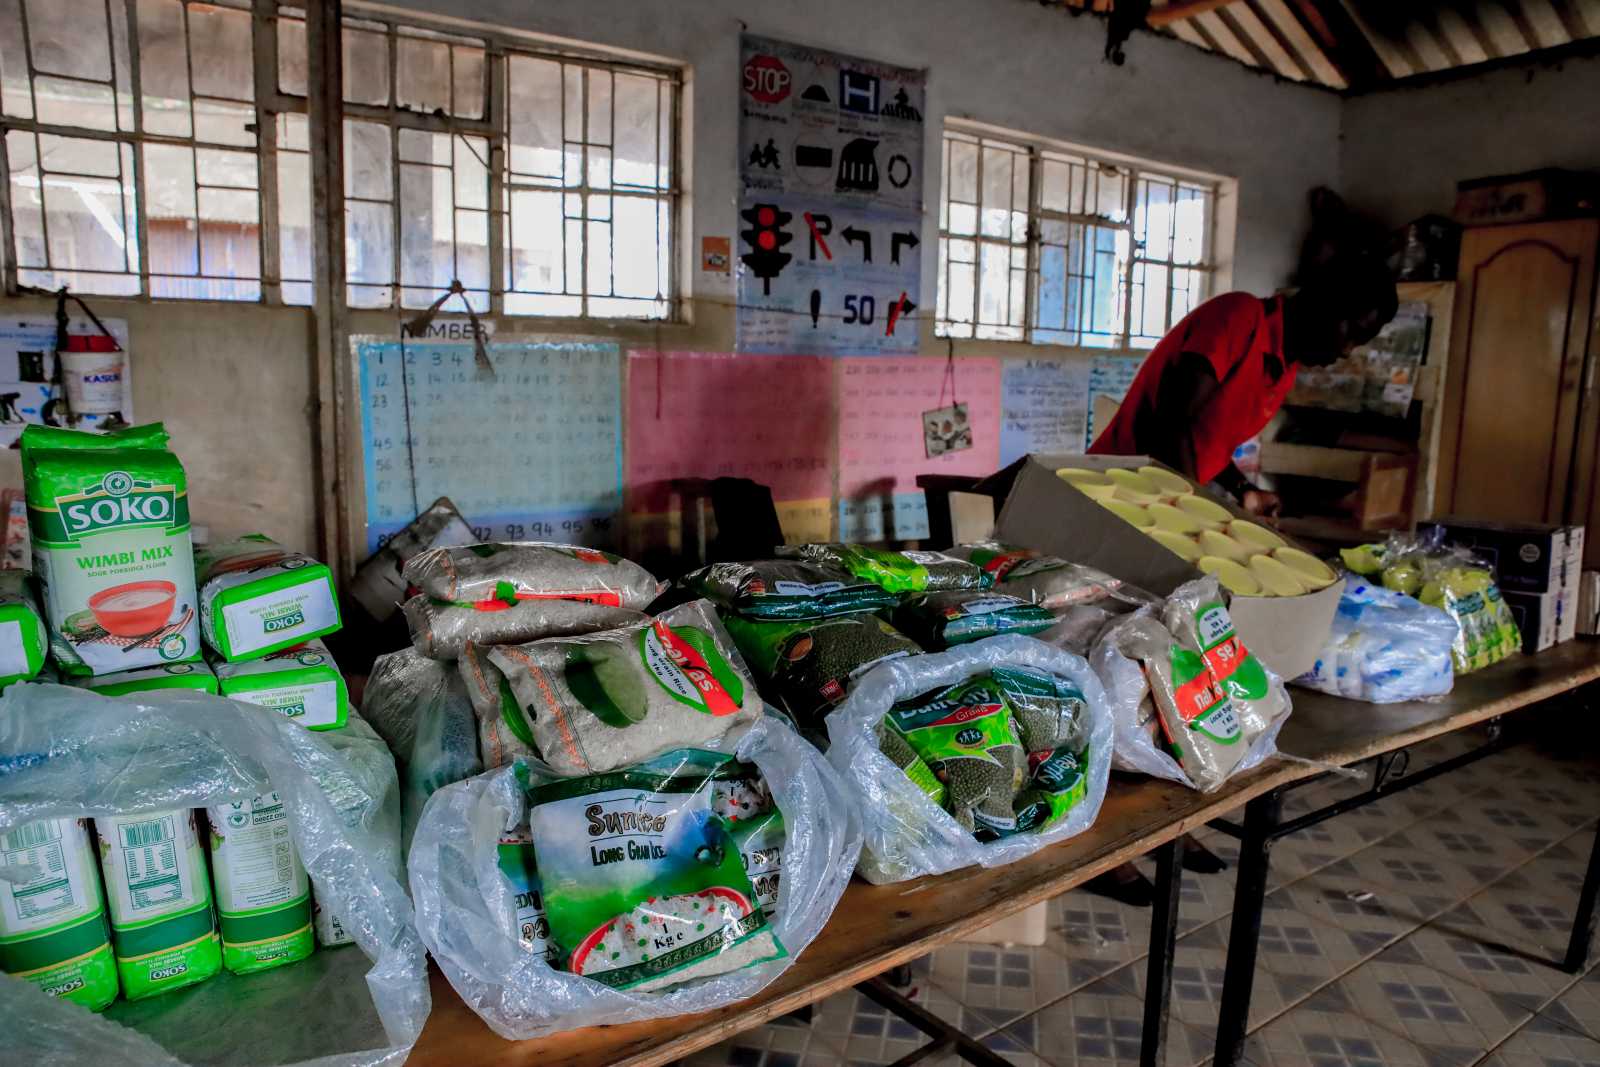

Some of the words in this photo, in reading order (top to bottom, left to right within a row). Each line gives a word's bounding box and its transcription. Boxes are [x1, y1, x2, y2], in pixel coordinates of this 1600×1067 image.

[744, 65, 790, 95] STOP
[843, 73, 876, 112] H
[842, 294, 875, 325] 50
[377, 351, 384, 364] 1
[406, 351, 417, 364] 2
[431, 354, 443, 367] 3
[450, 354, 463, 367] 4
[375, 374, 390, 388] 12
[371, 395, 388, 409] 23
[373, 437, 392, 450] 45
[67, 495, 170, 530] SOKO
[505, 524, 527, 540] 93
[531, 522, 554, 536] 94
[561, 520, 584, 534] 95
[75, 551, 136, 570] WIMBI
[141, 544, 174, 562] MIX
[265, 612, 303, 631] SOKO
[652, 663, 664, 676] 1kg
[672, 677, 687, 695] Rice
[590, 844, 627, 867] LONG
[152, 963, 186, 979] SOKO
